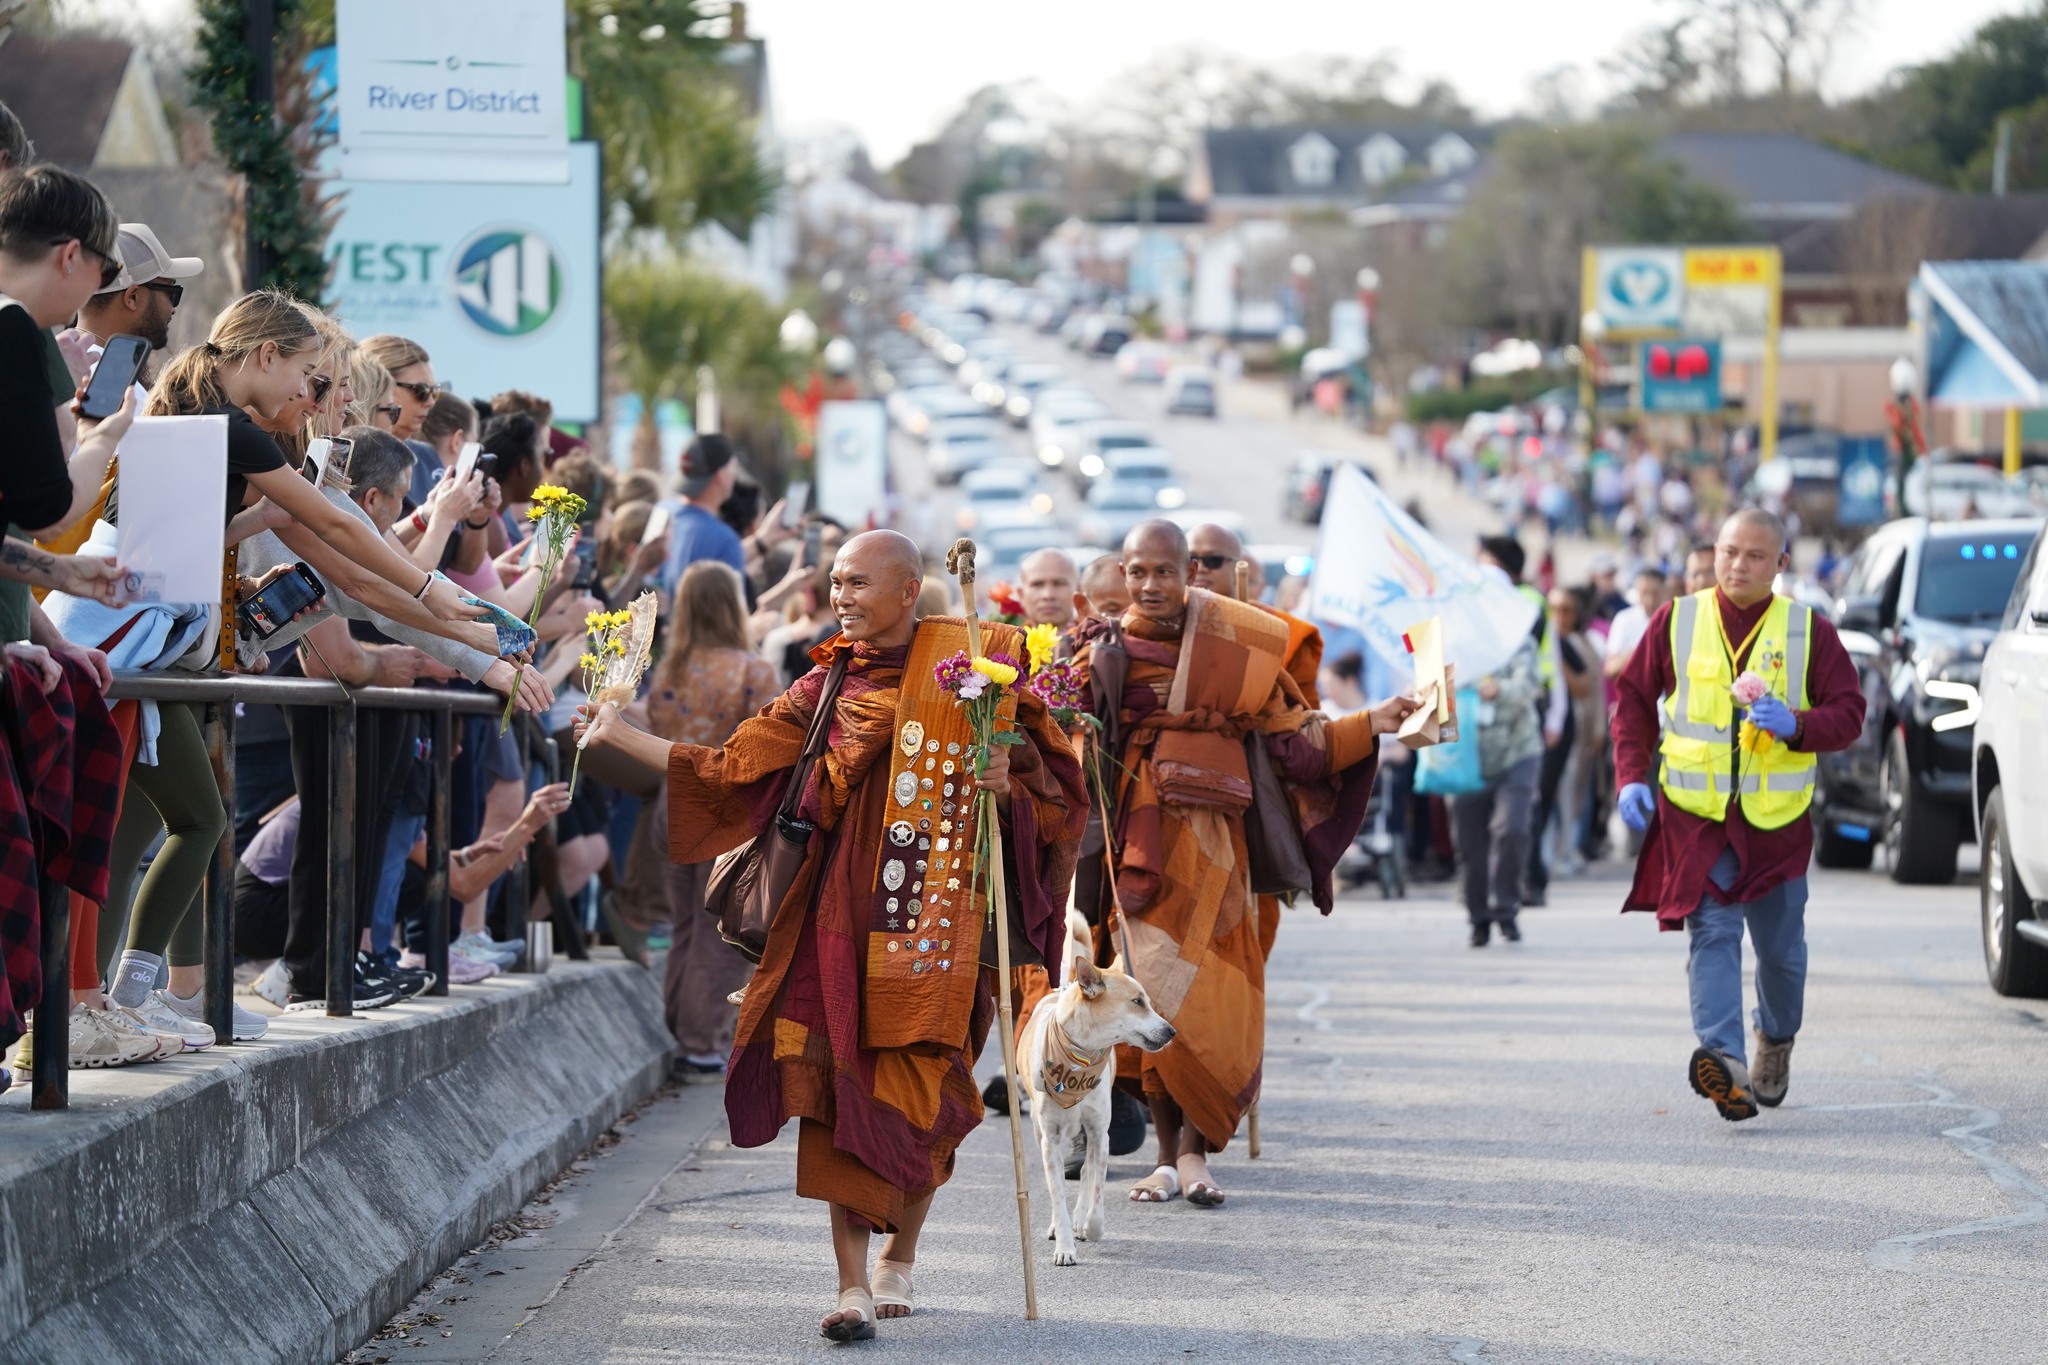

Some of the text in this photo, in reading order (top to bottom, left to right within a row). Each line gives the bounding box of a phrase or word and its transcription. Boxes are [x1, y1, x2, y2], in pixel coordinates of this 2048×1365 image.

[368, 85, 541, 113] River District
[131, 970, 151, 983] alo
[150, 1014, 178, 1029] HOKA
[1050, 1063, 1096, 1091] Aloka
